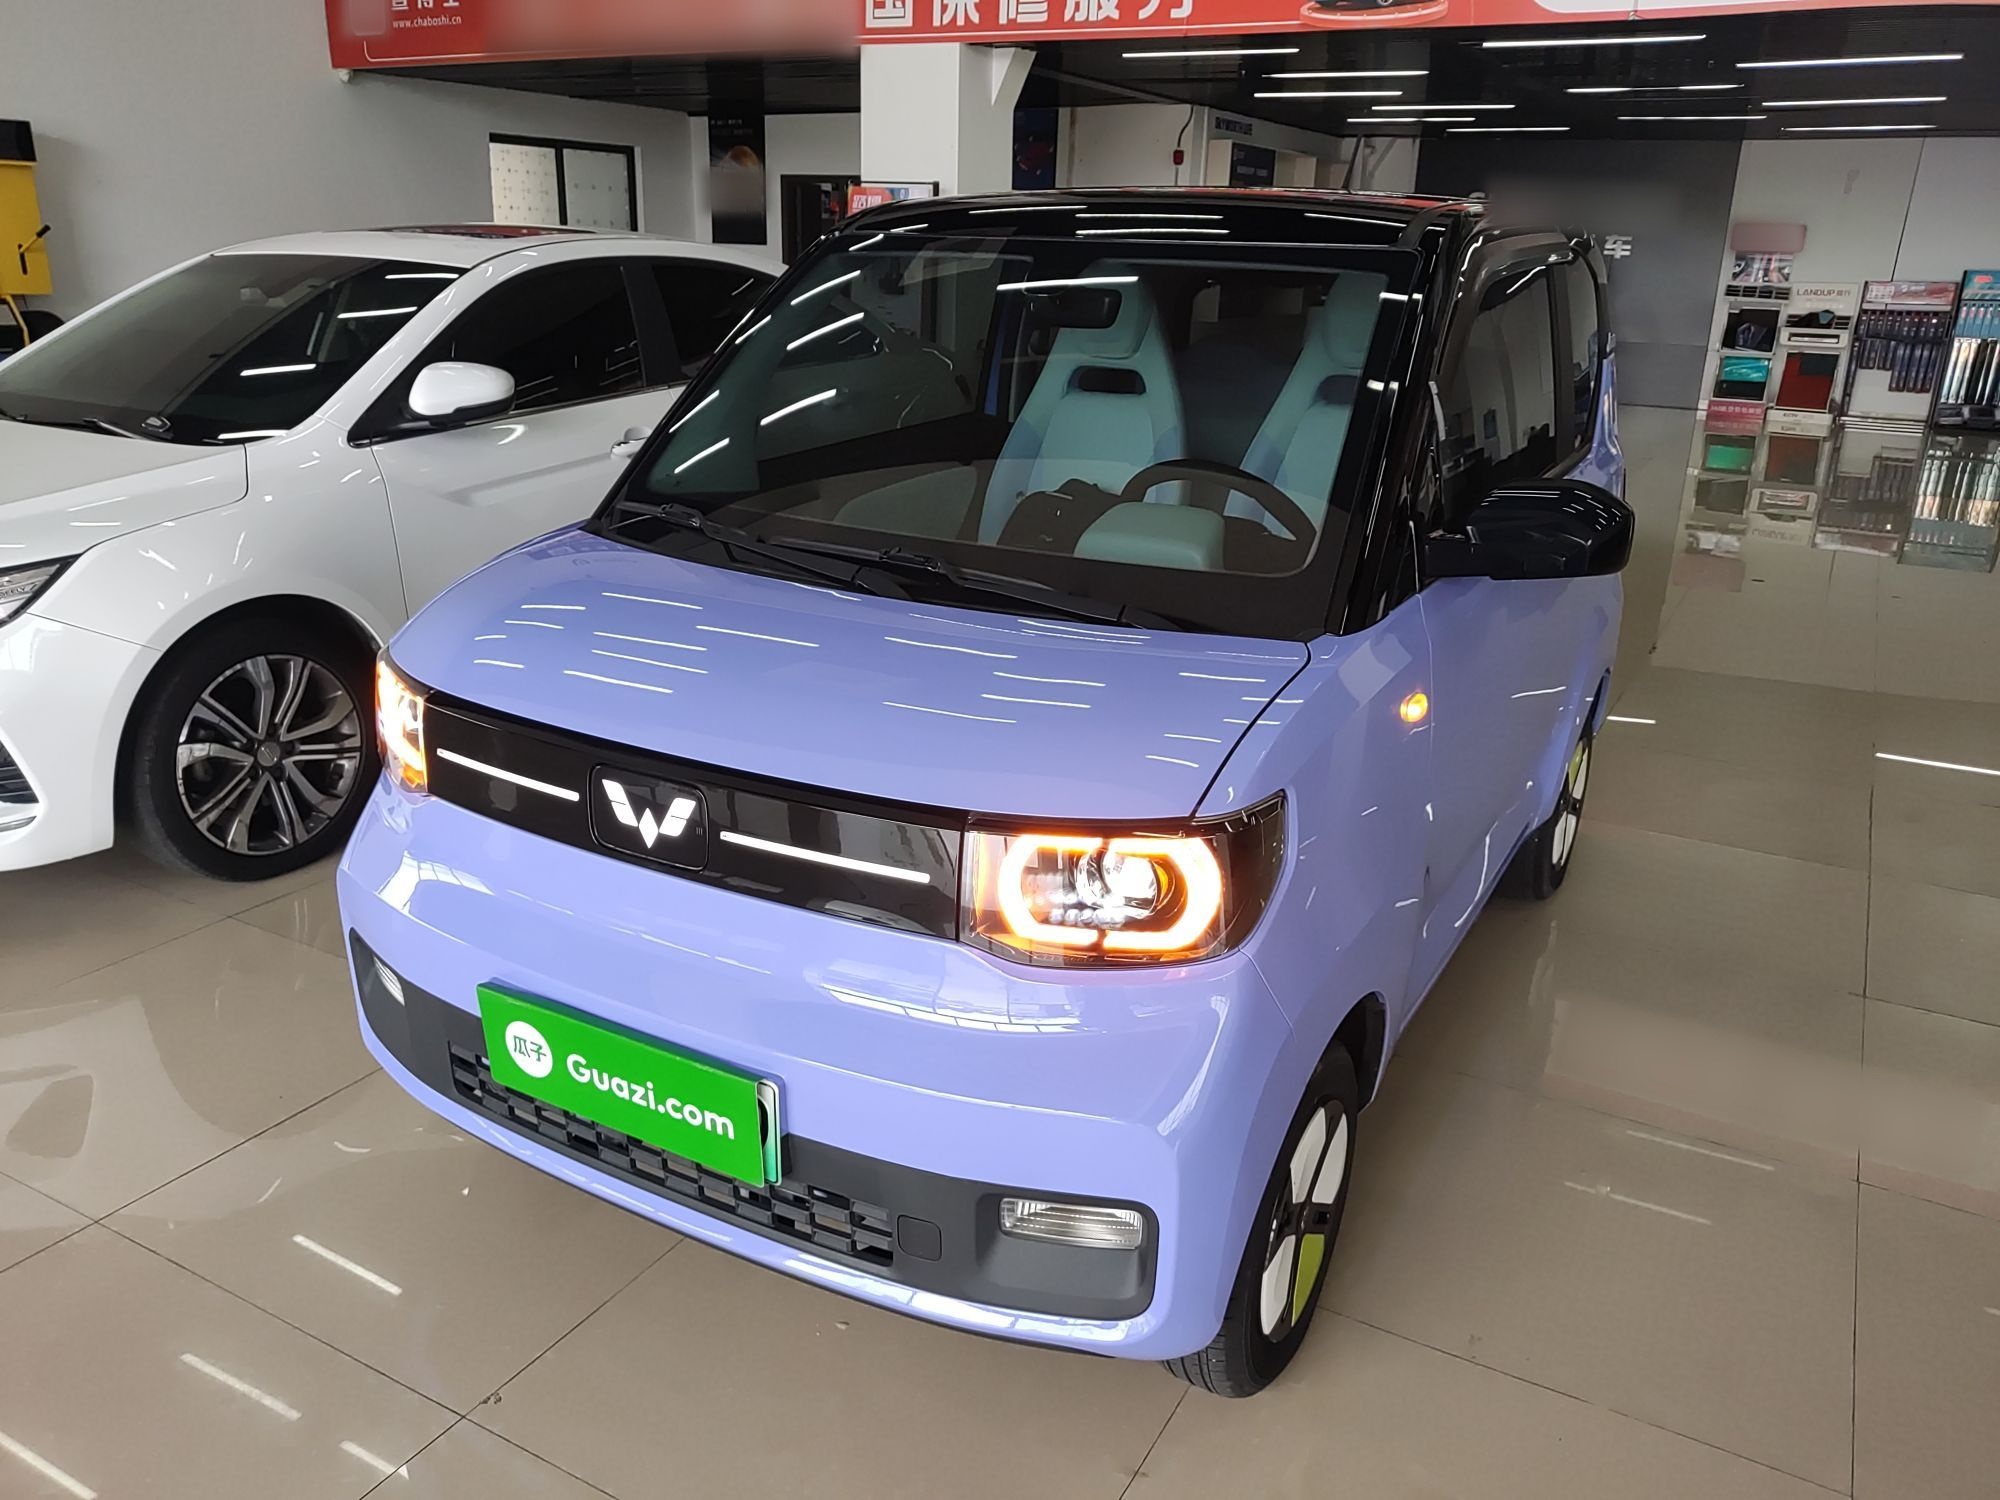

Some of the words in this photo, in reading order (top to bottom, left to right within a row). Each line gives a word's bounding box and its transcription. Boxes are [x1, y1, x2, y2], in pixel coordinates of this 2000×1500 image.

[392, 14, 462, 28] www.chaboshi.cn
[1603, 235, 1632, 259] 车
[1797, 288, 1835, 297] LANDUP
[513, 1035, 547, 1062] 瓜子
[566, 1053, 735, 1140] Guazi.com
